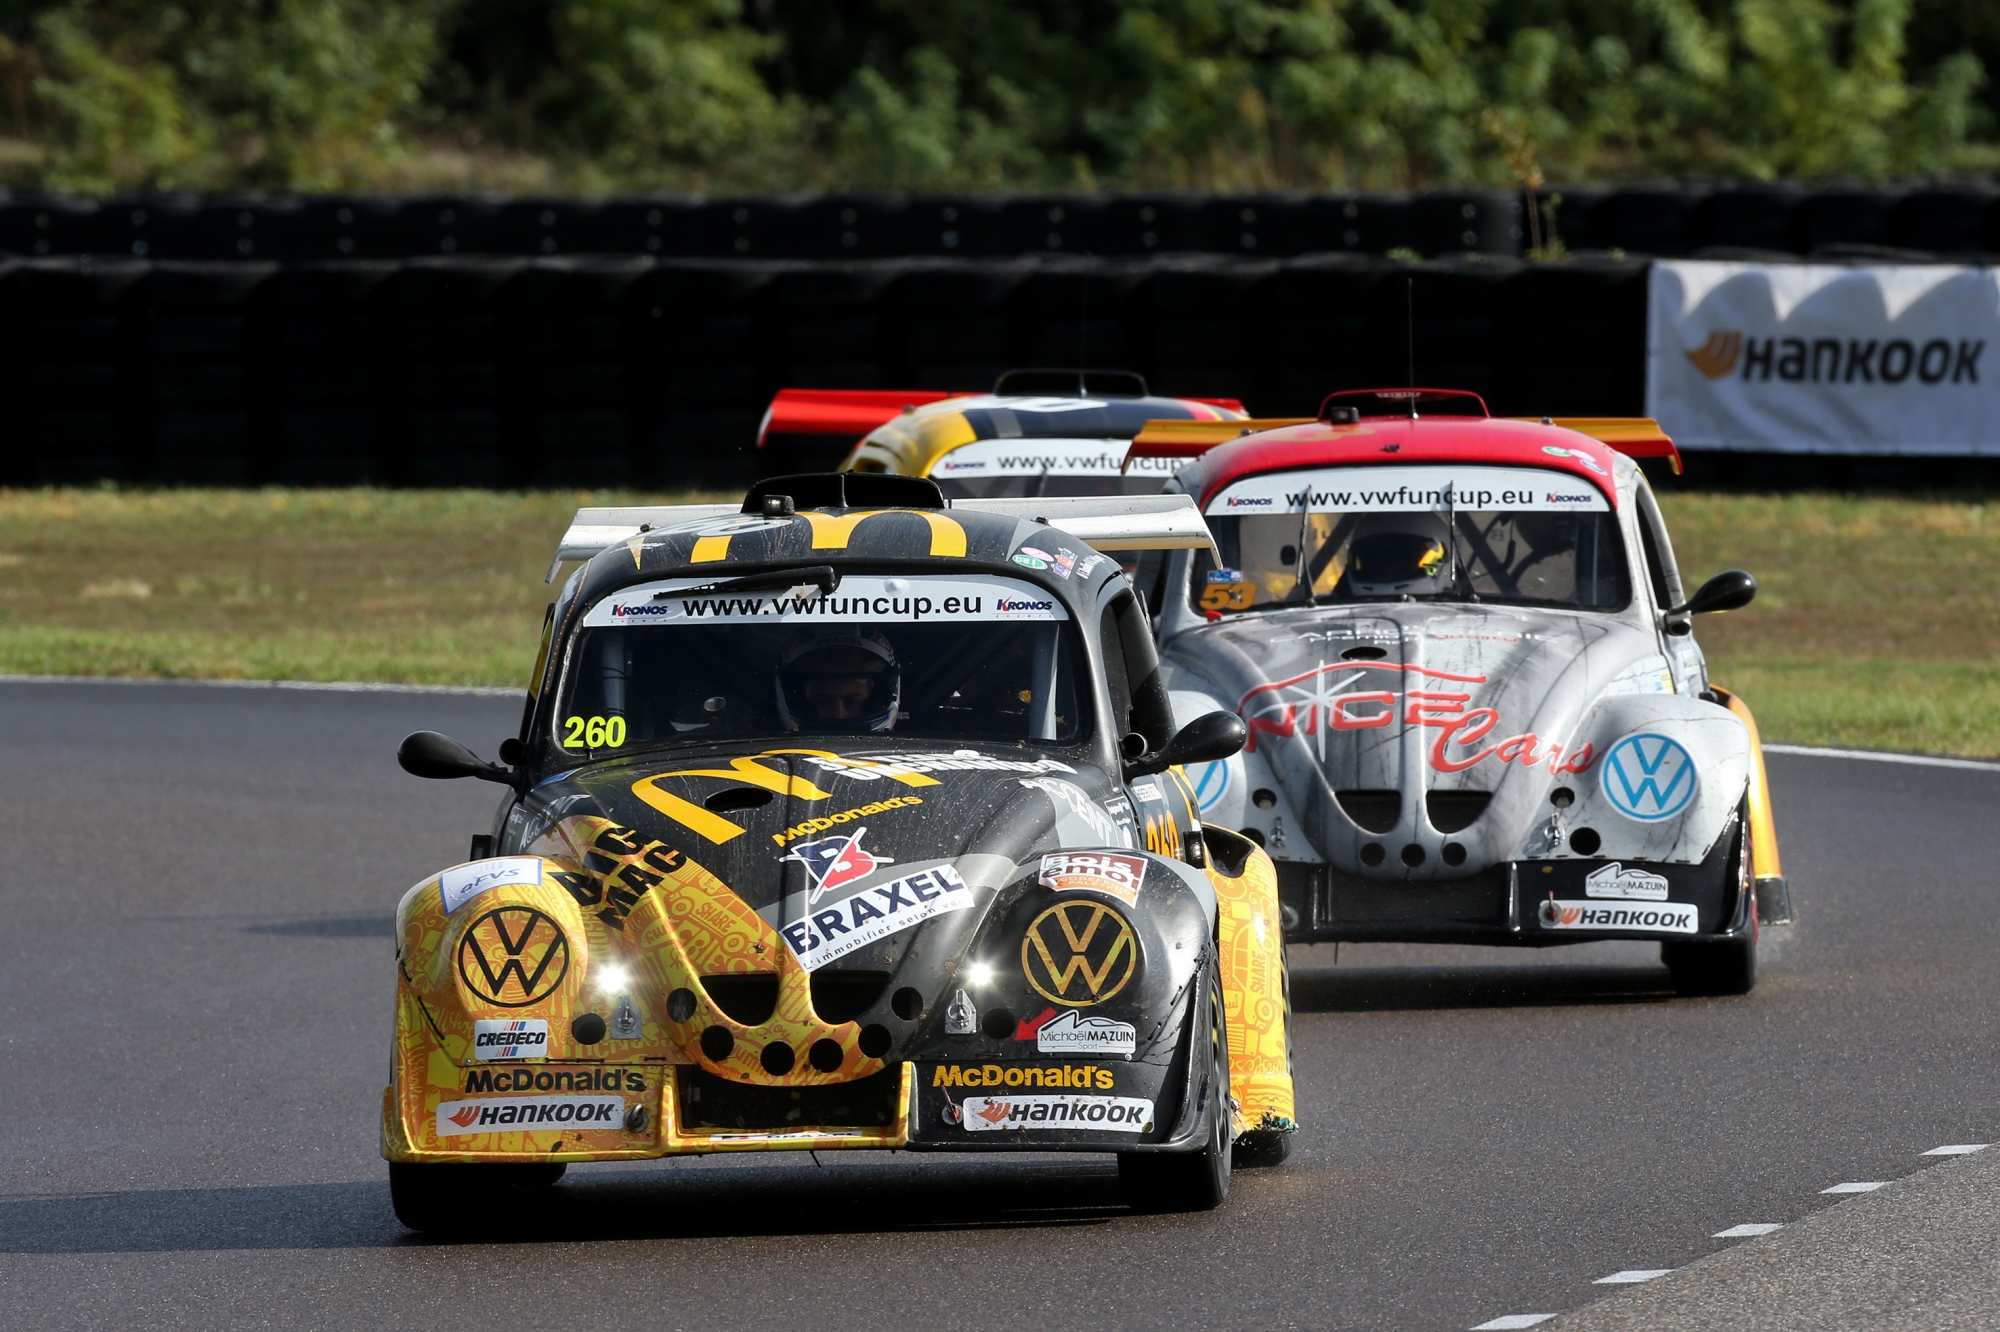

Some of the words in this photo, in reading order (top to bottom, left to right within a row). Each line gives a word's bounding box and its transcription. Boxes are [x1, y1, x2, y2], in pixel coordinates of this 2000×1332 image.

[1227, 494, 1273, 507] KRONOS
[1285, 485, 1533, 509] www.vwfuncup.eu
[1546, 490, 1593, 504] KRONOS
[611, 600, 668, 616] KRONOS
[682, 592, 982, 620] www.vwfuncup.eu
[996, 595, 1053, 612] KRONOS
[1199, 583, 1257, 611] 53
[563, 715, 627, 748] 260
[1243, 690, 1471, 753] NICE
[1428, 707, 1601, 774] Cars
[771, 795, 924, 847] McDonald's
[546, 826, 652, 907] BIG
[596, 844, 688, 932] MAC
[1628, 881, 1667, 891] MAZUIN
[695, 902, 736, 932] SHARE
[782, 870, 965, 955] BRAXEL
[899, 907, 936, 926] selon
[1250, 953, 1266, 995] SHARE
[476, 1032, 547, 1047] CREDECO
[1040, 1030, 1087, 1041] Michaël
[1087, 1030, 1135, 1042] MAZUIN
[1078, 1041, 1098, 1050] Sport
[465, 1068, 648, 1094] McDonald's
[932, 1064, 1114, 1090] McDonald's
